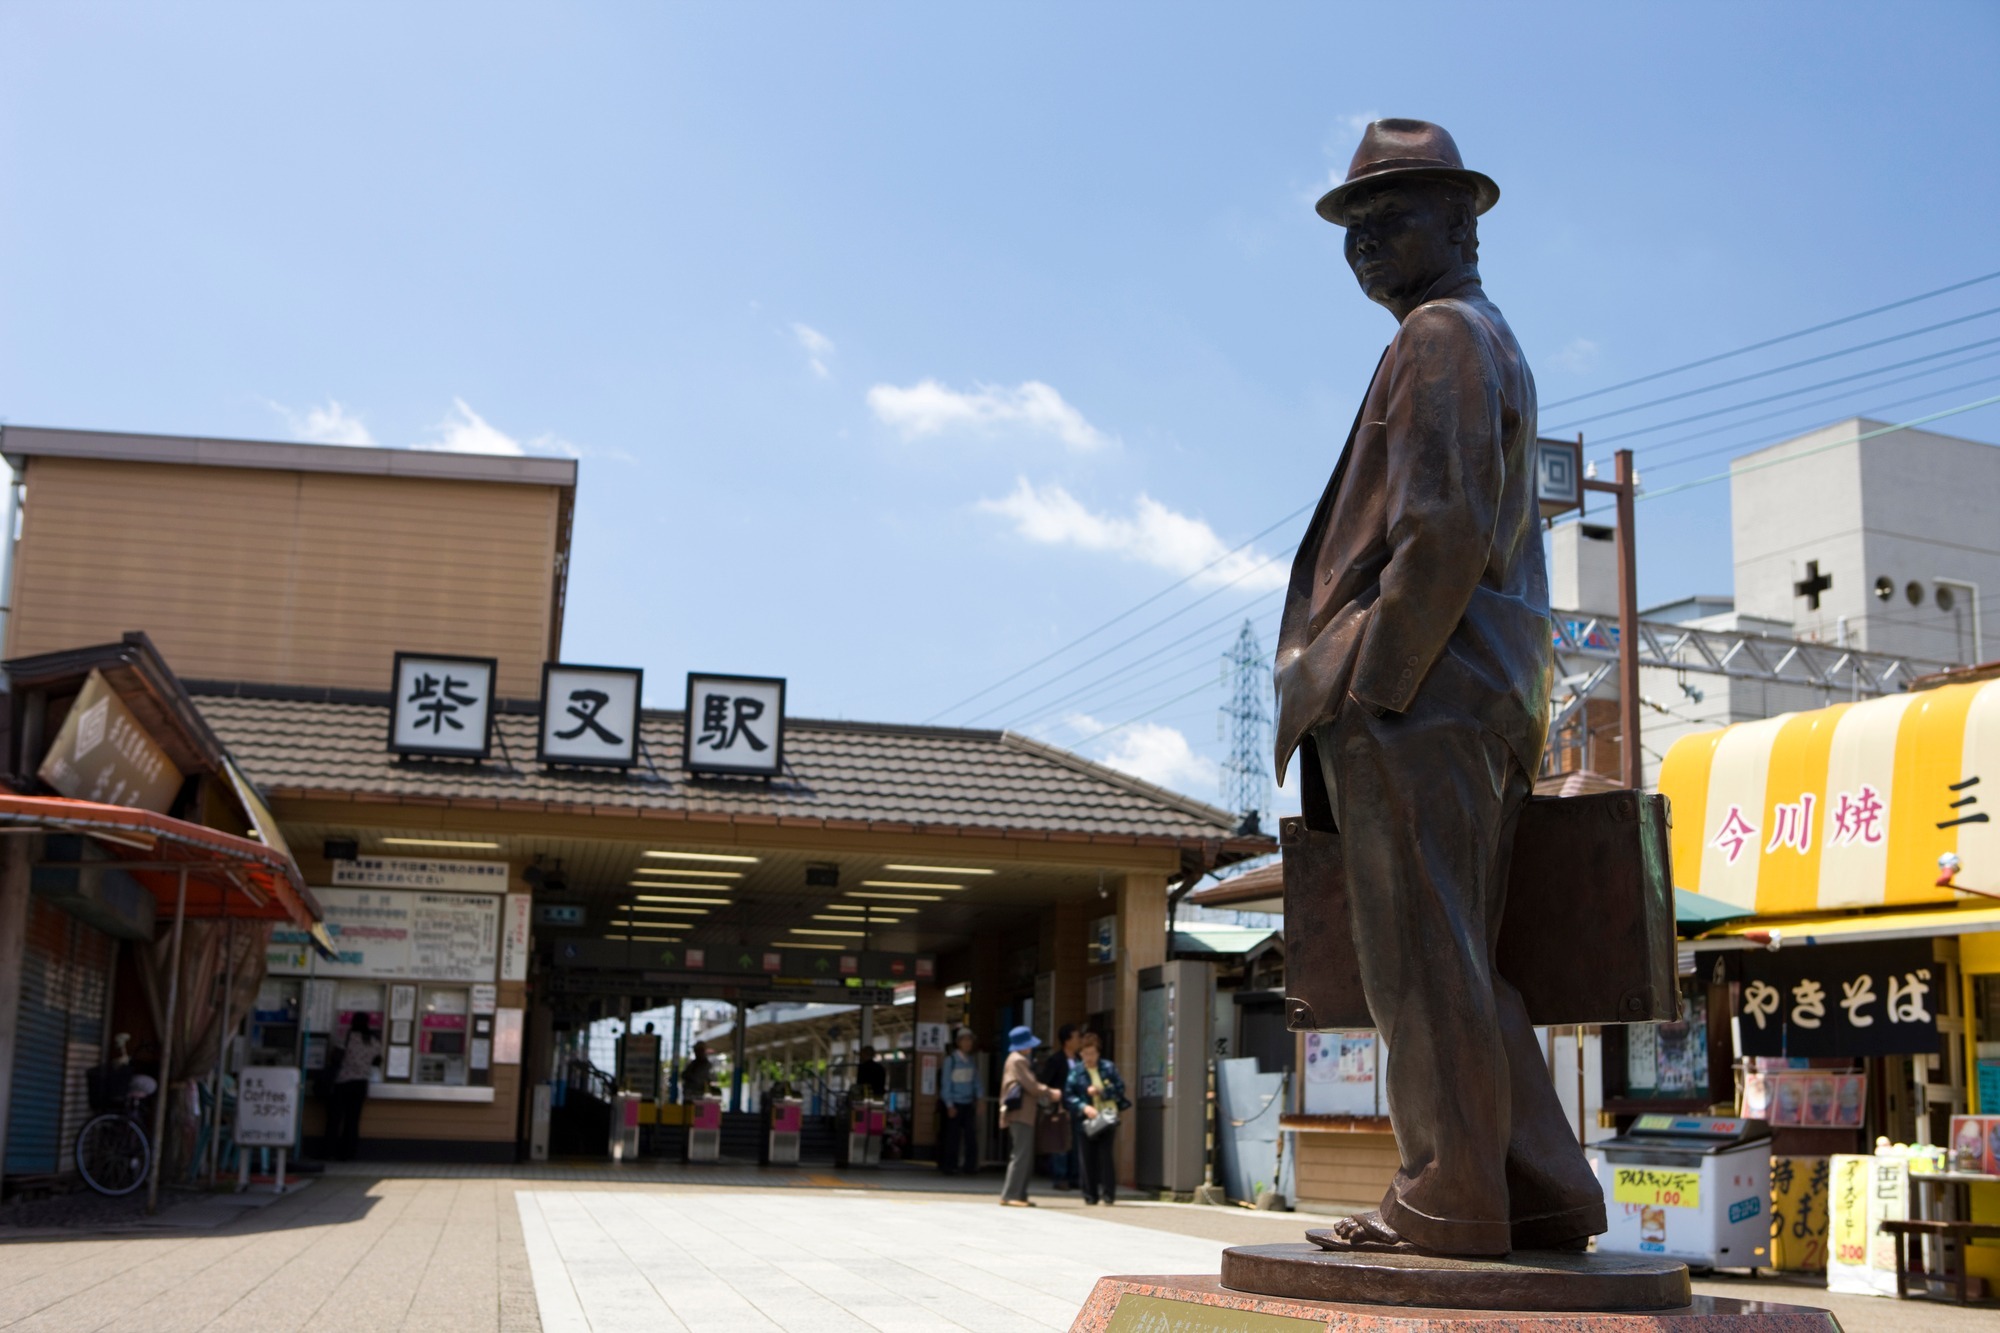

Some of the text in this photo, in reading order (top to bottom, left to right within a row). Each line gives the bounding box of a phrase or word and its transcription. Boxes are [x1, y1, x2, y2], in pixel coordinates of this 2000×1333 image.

[1711, 785, 1885, 863] 今川焼
[1743, 969, 1932, 1030] やきそば
[243, 1090, 287, 1102] Coffee
[1712, 1121, 1736, 1133] 100
[1618, 1169, 1697, 1191] アイスキャンディー
